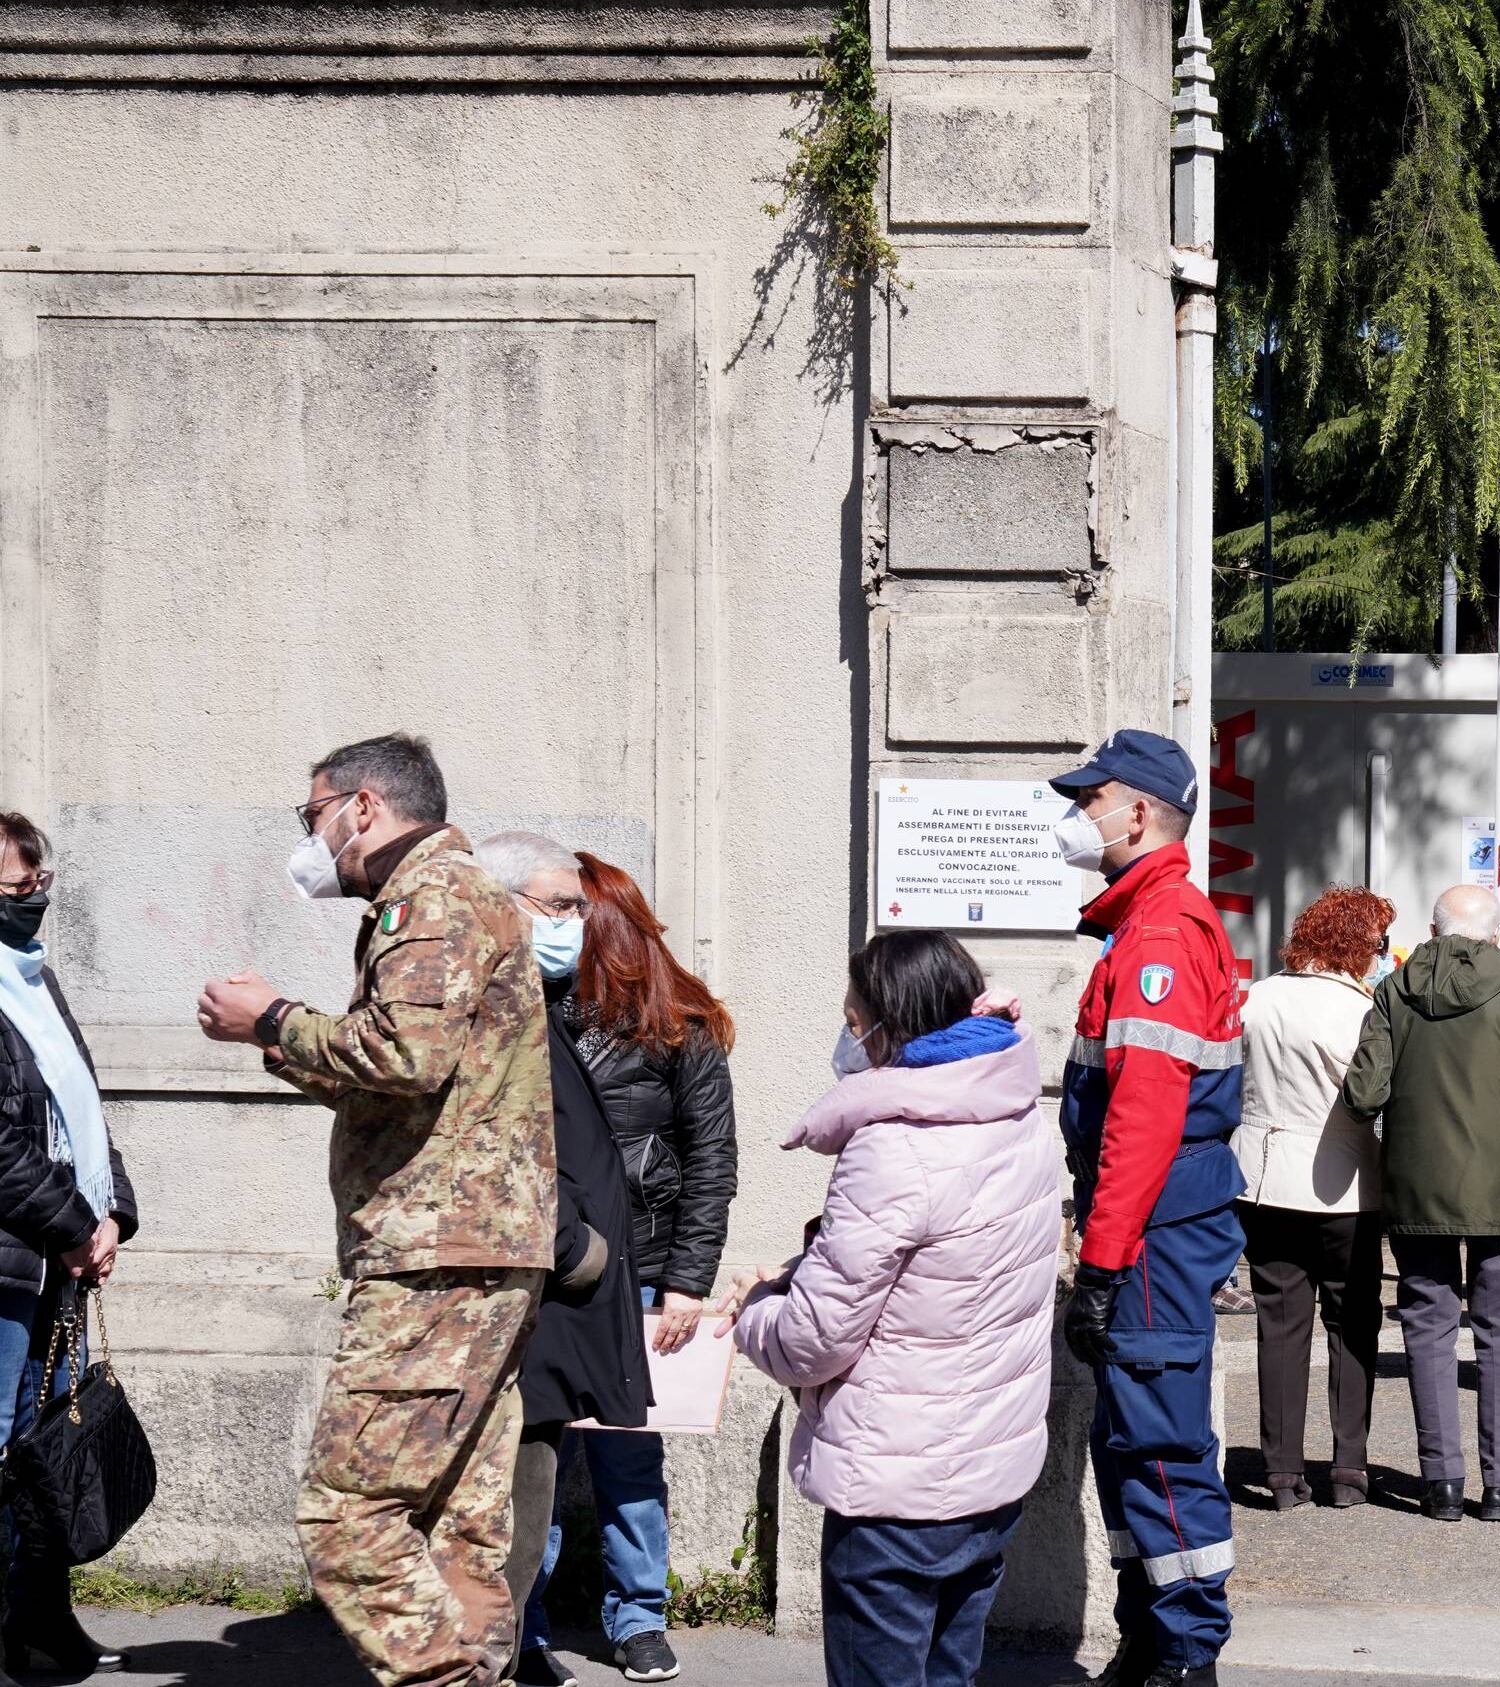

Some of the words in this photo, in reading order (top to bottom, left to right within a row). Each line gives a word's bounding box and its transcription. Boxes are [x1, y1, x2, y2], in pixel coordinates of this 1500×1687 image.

[931, 807, 945, 817] AL
[946, 808, 970, 817] FINE
[972, 808, 983, 817] DI
[984, 809, 1029, 818] EVITARE
[897, 821, 983, 831] ASSEMBRAMENTI
[984, 822, 992, 831] E
[994, 821, 1050, 832] DISSERVIZI
[921, 834, 955, 844] PREGA
[956, 835, 968, 844] DI
[969, 835, 1039, 845] PRESENTARSI
[897, 847, 987, 858] ESCLUSIVAMENTE
[989, 849, 1049, 859] ALL'ORARIO
[1051, 850, 1062, 859] DI
[938, 862, 1021, 872] CONVOCAZIONE.
[895, 876, 939, 884] VERRANNO
[941, 877, 986, 885] VACCINATE
[989, 878, 1011, 886] SOLO
[1013, 878, 1024, 886] LE
[1026, 879, 1063, 887] PERSONE
[895, 886, 932, 894] INSERITE
[933, 887, 959, 895] NELLA
[960, 888, 983, 896] LISTA
[984, 888, 1032, 897] REGIONALE.
